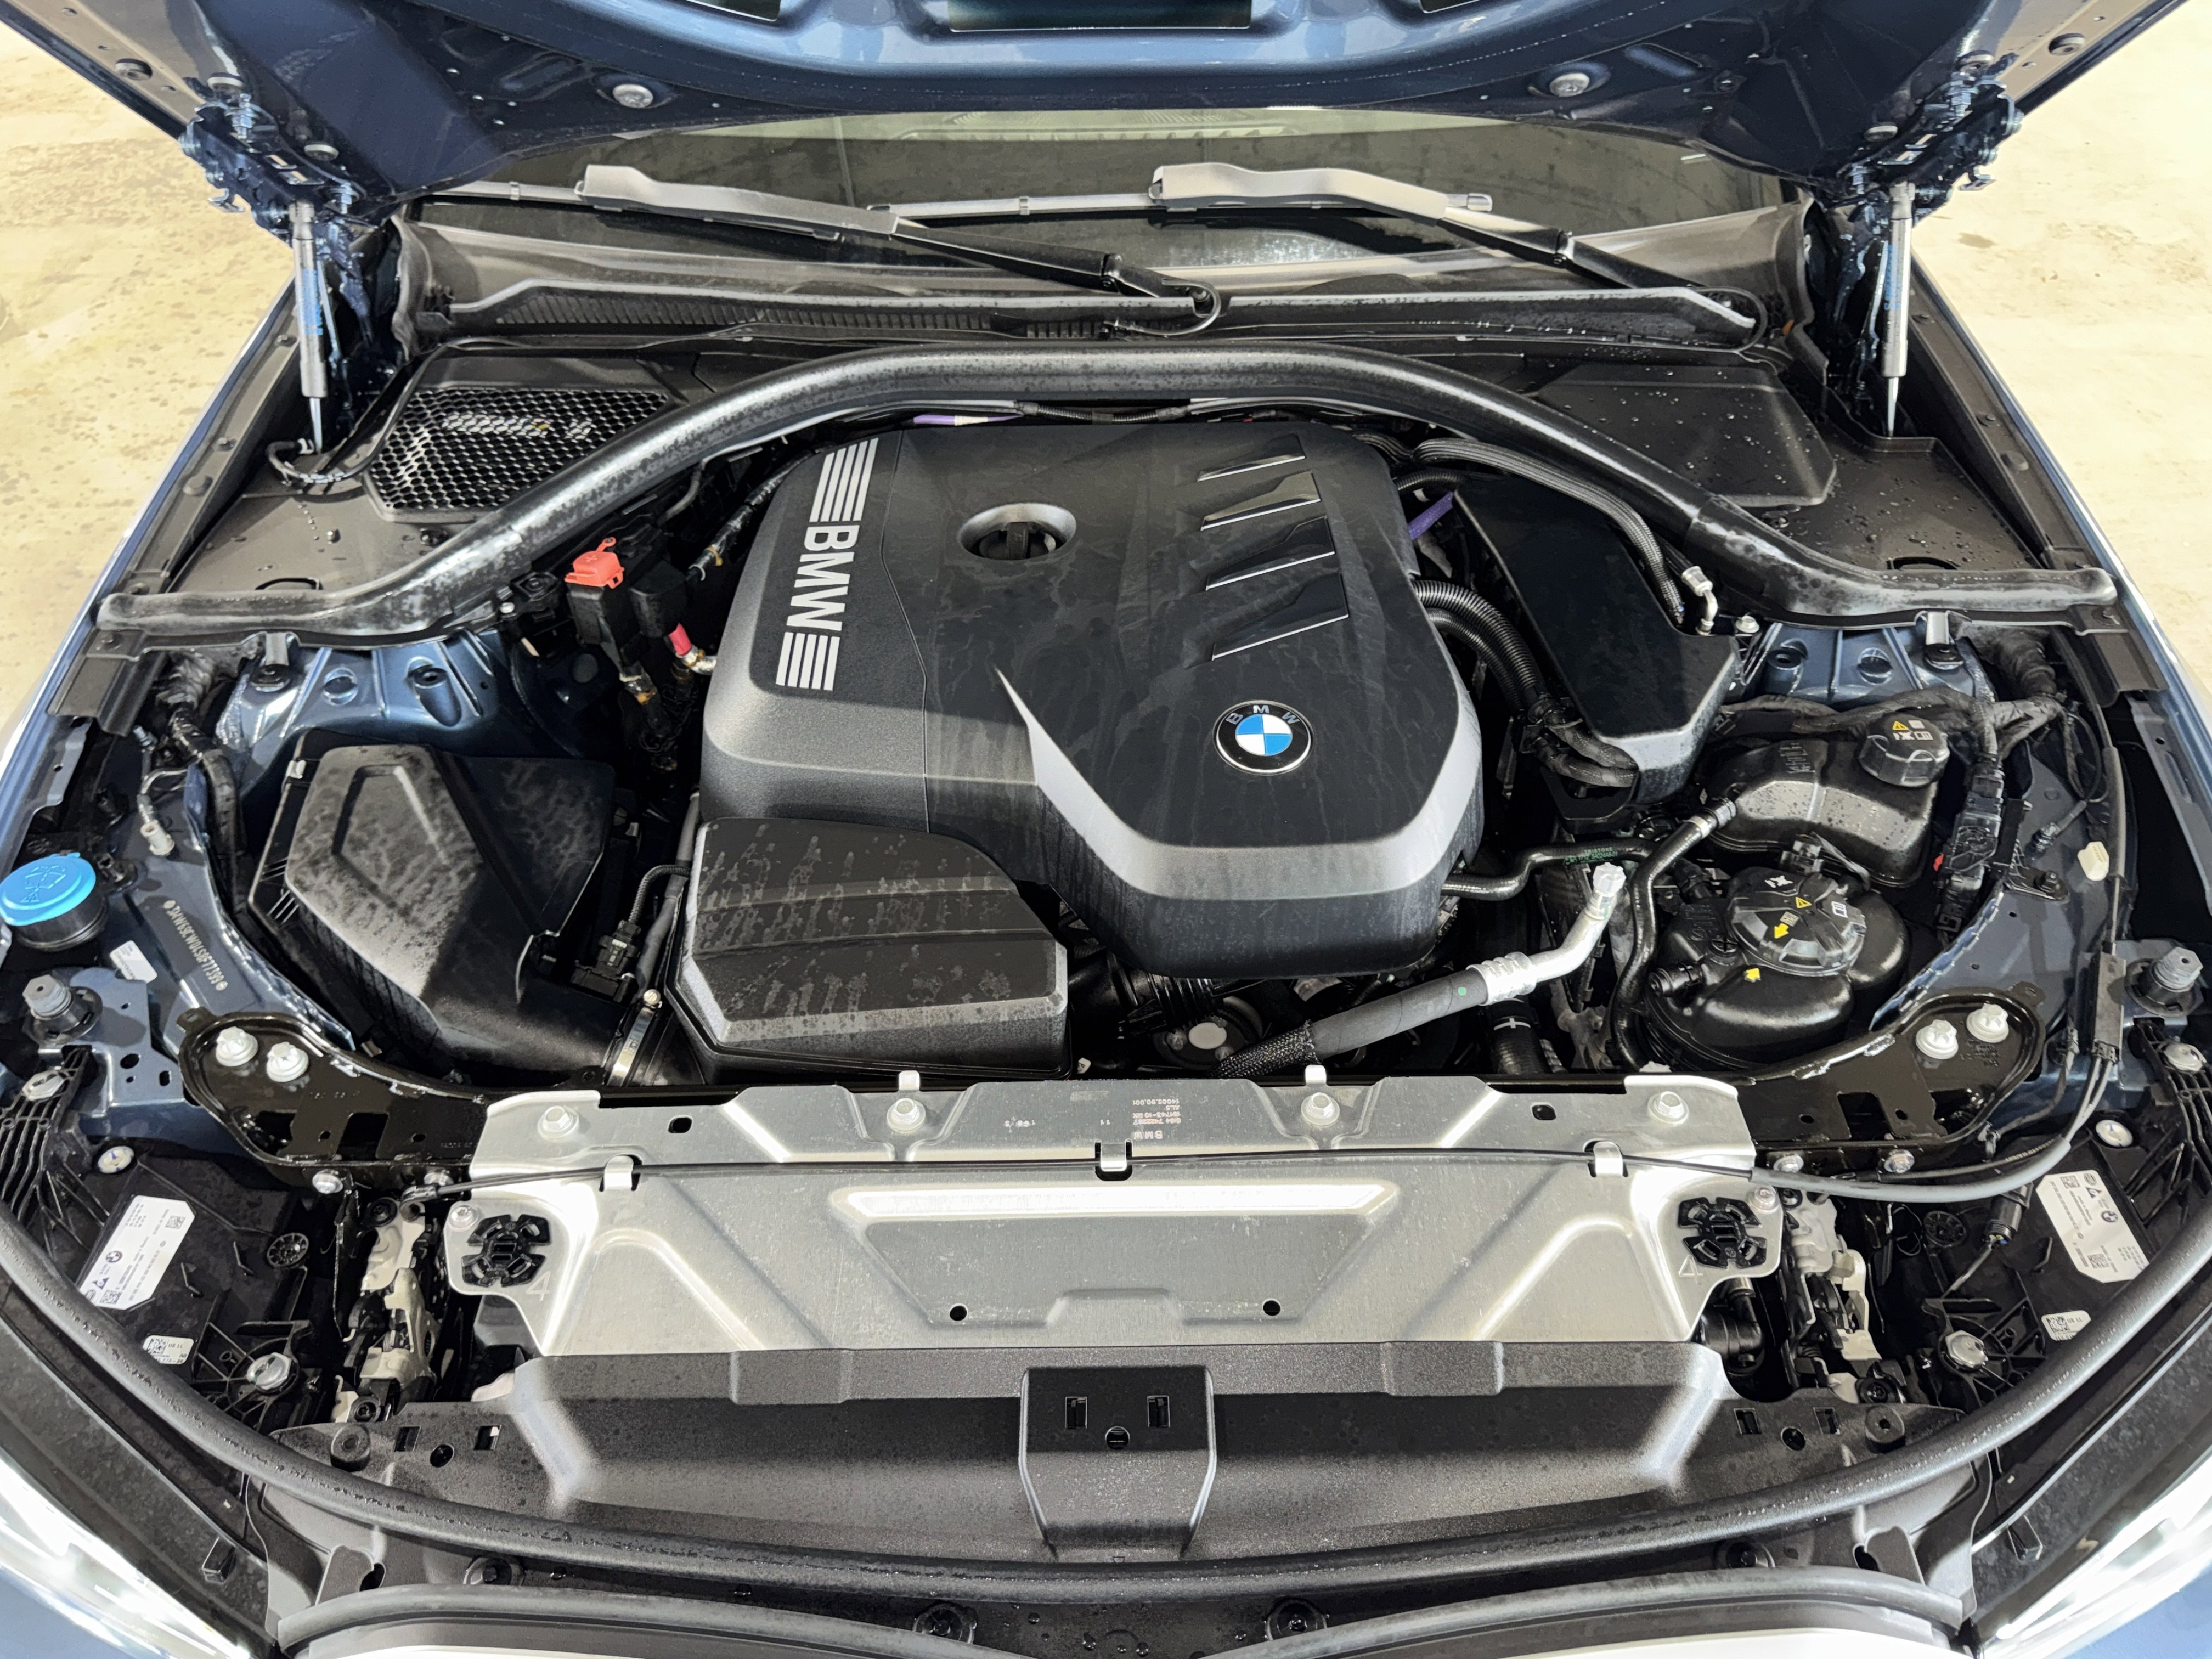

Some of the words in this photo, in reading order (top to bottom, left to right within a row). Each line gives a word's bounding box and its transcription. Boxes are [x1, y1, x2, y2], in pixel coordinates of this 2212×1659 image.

[786, 524, 860, 631] BMW
[1225, 704, 1300, 725] BMW
[1133, 1130, 1163, 1139] BMW
[526, 1271, 551, 1301] 4
